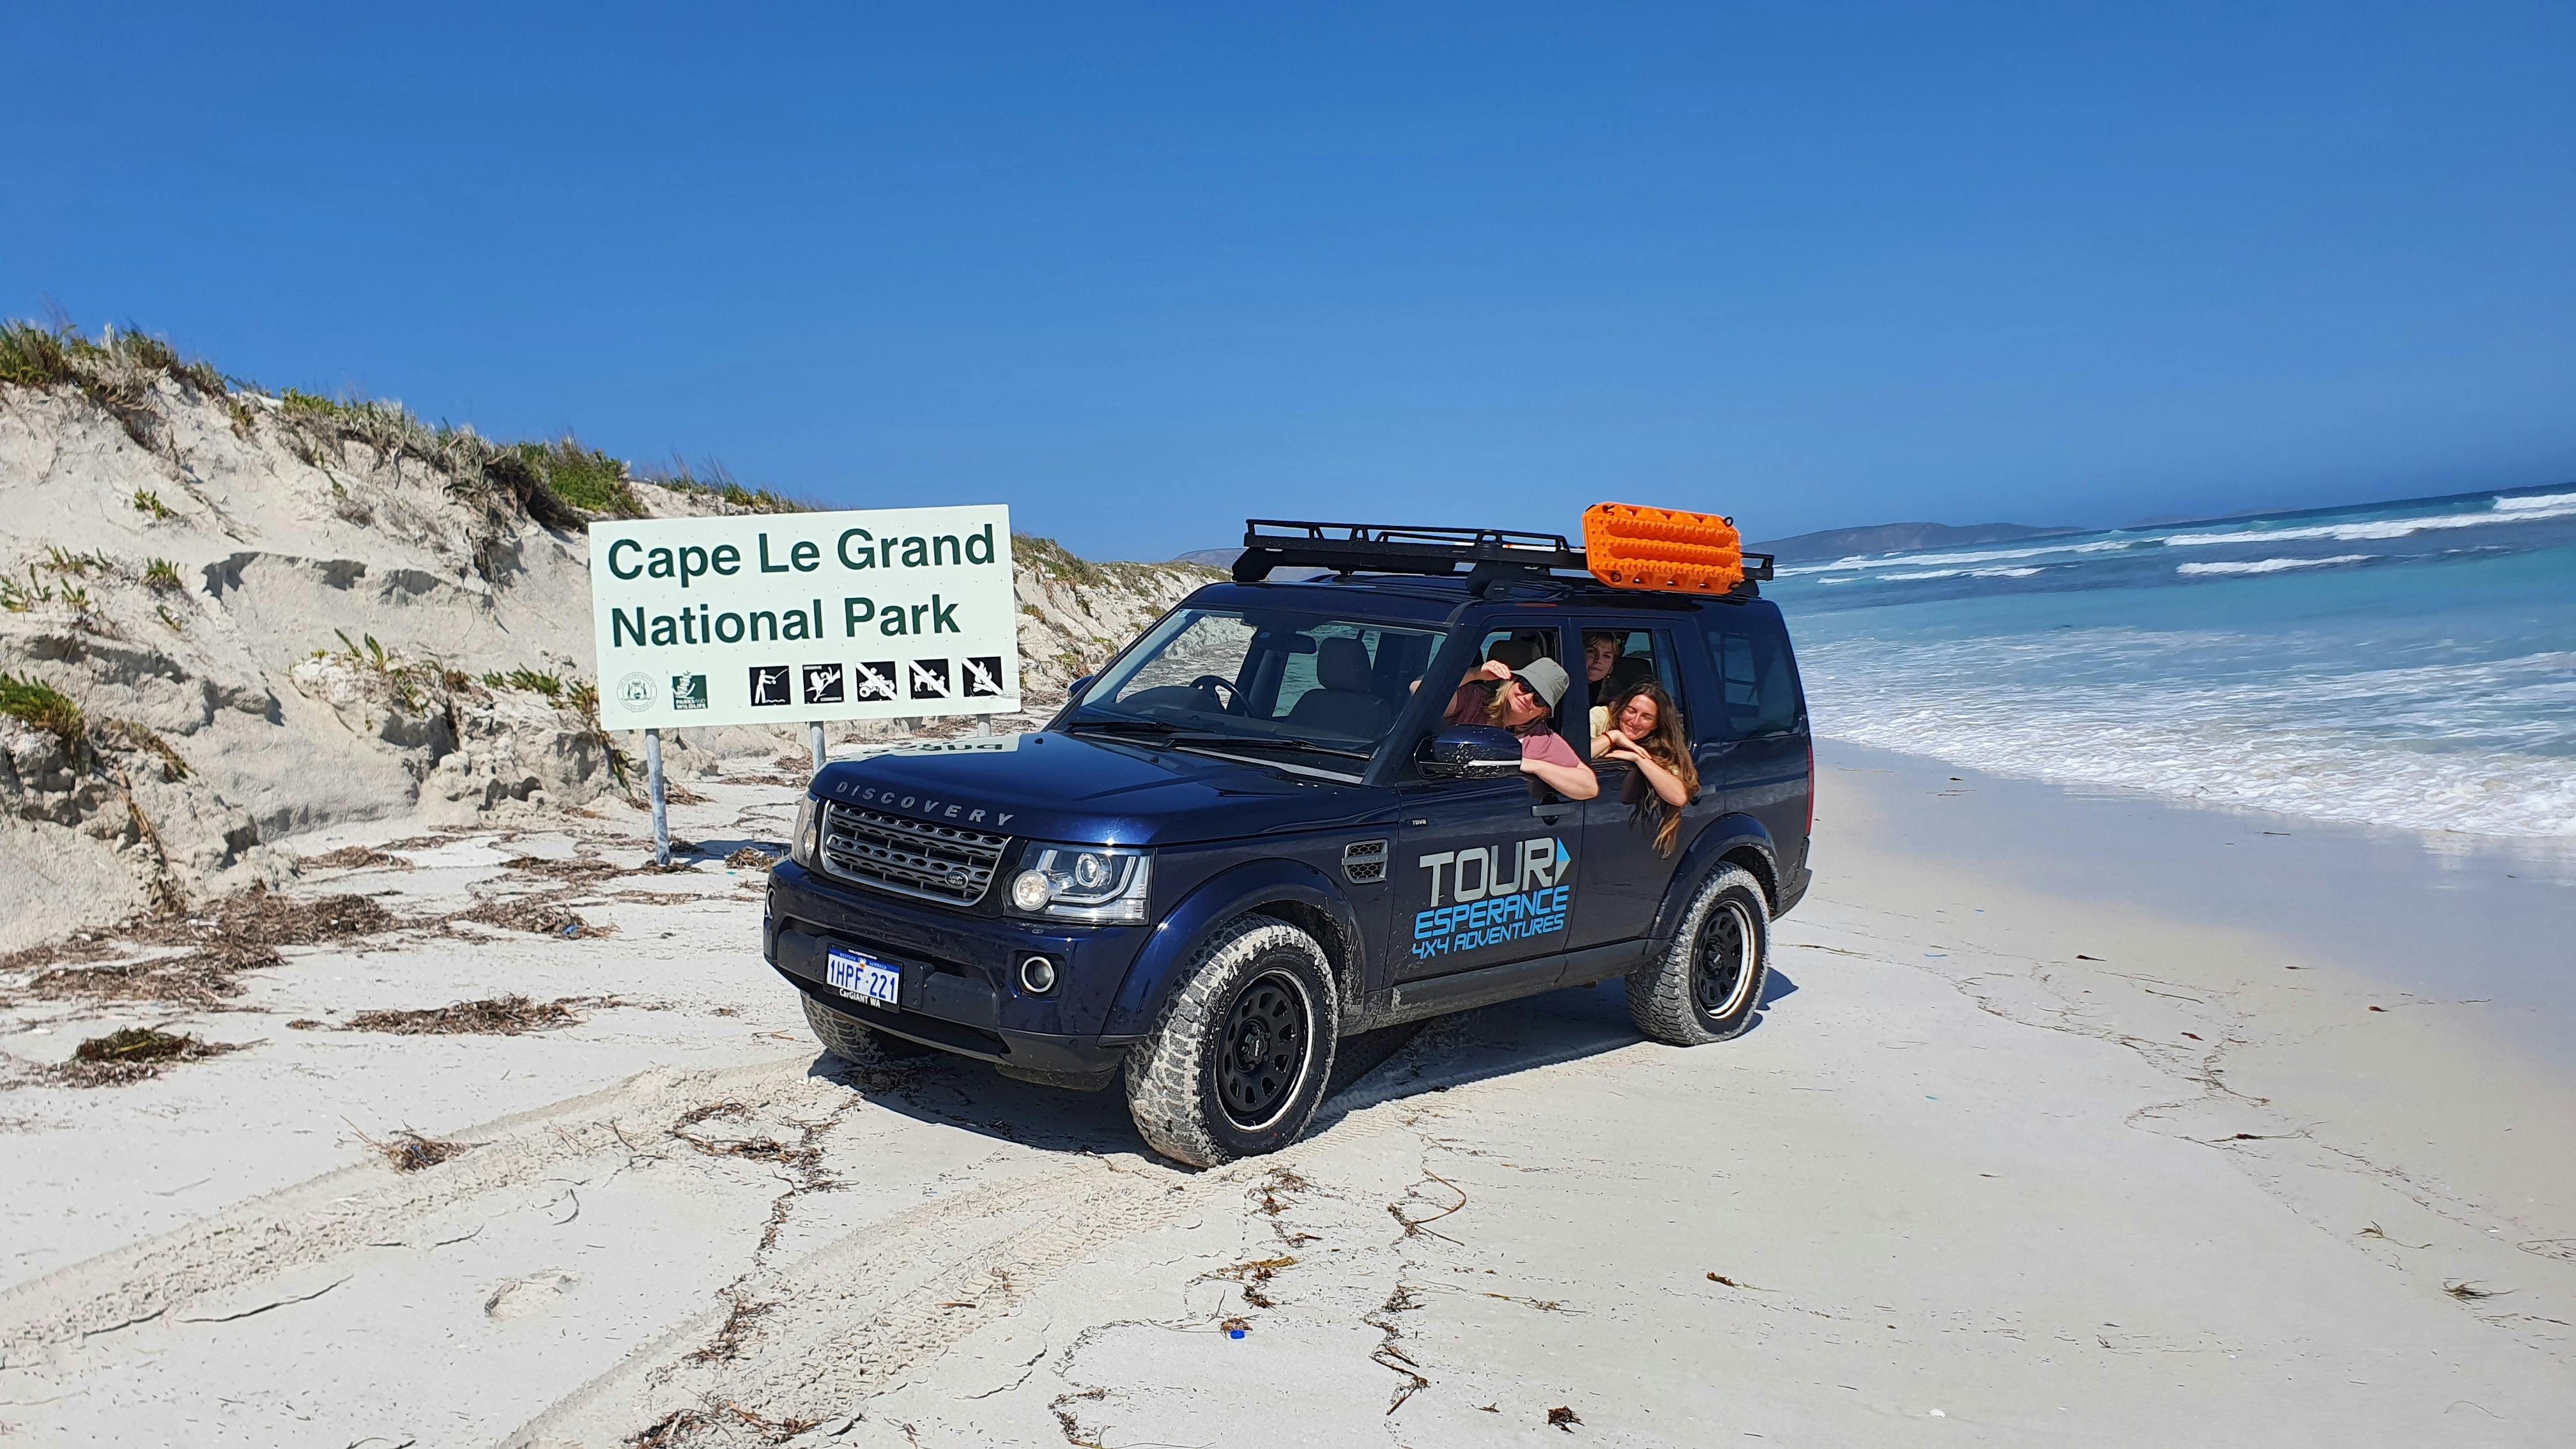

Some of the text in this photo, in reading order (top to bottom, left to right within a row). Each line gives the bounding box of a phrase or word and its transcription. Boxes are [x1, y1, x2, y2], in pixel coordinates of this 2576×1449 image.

[609, 524, 994, 588] Cape Le Grand
[612, 594, 961, 647] National Park
[836, 781, 1014, 826] DISCOVERY
[1419, 837, 1555, 908] TOUR
[1414, 885, 1569, 940] ESPERANCE
[1453, 912, 1565, 952] ADVENTURES
[839, 988, 880, 1008] CarGIANT WA
